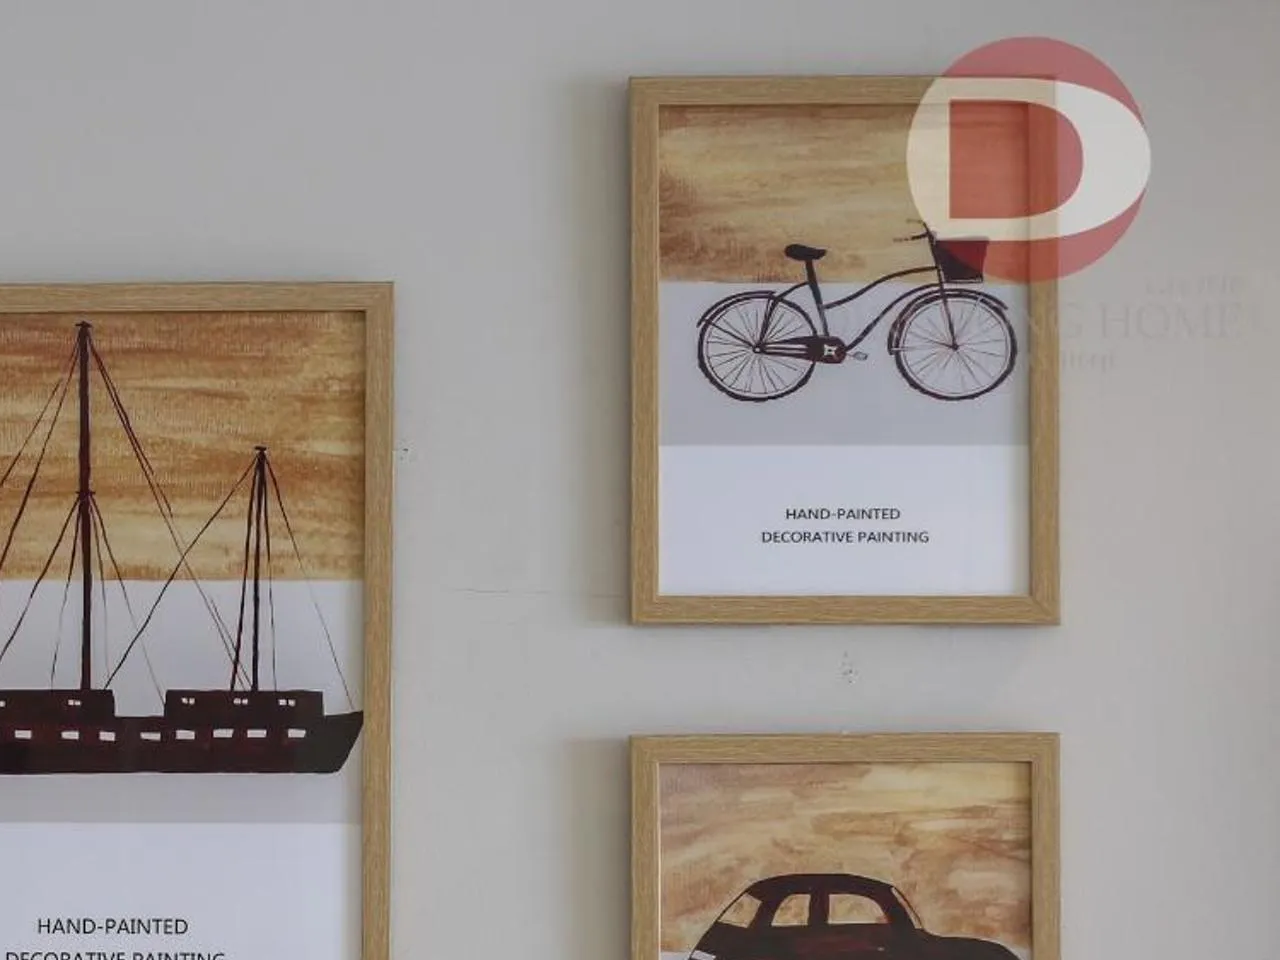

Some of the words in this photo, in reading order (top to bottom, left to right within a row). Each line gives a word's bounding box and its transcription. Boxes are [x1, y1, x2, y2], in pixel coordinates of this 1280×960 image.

[785, 507, 901, 520] HAND-PAINTED
[761, 531, 853, 544] DECORATIVE
[857, 531, 930, 544] PAINTING
[37, 917, 189, 935] HAND-PAINTED
